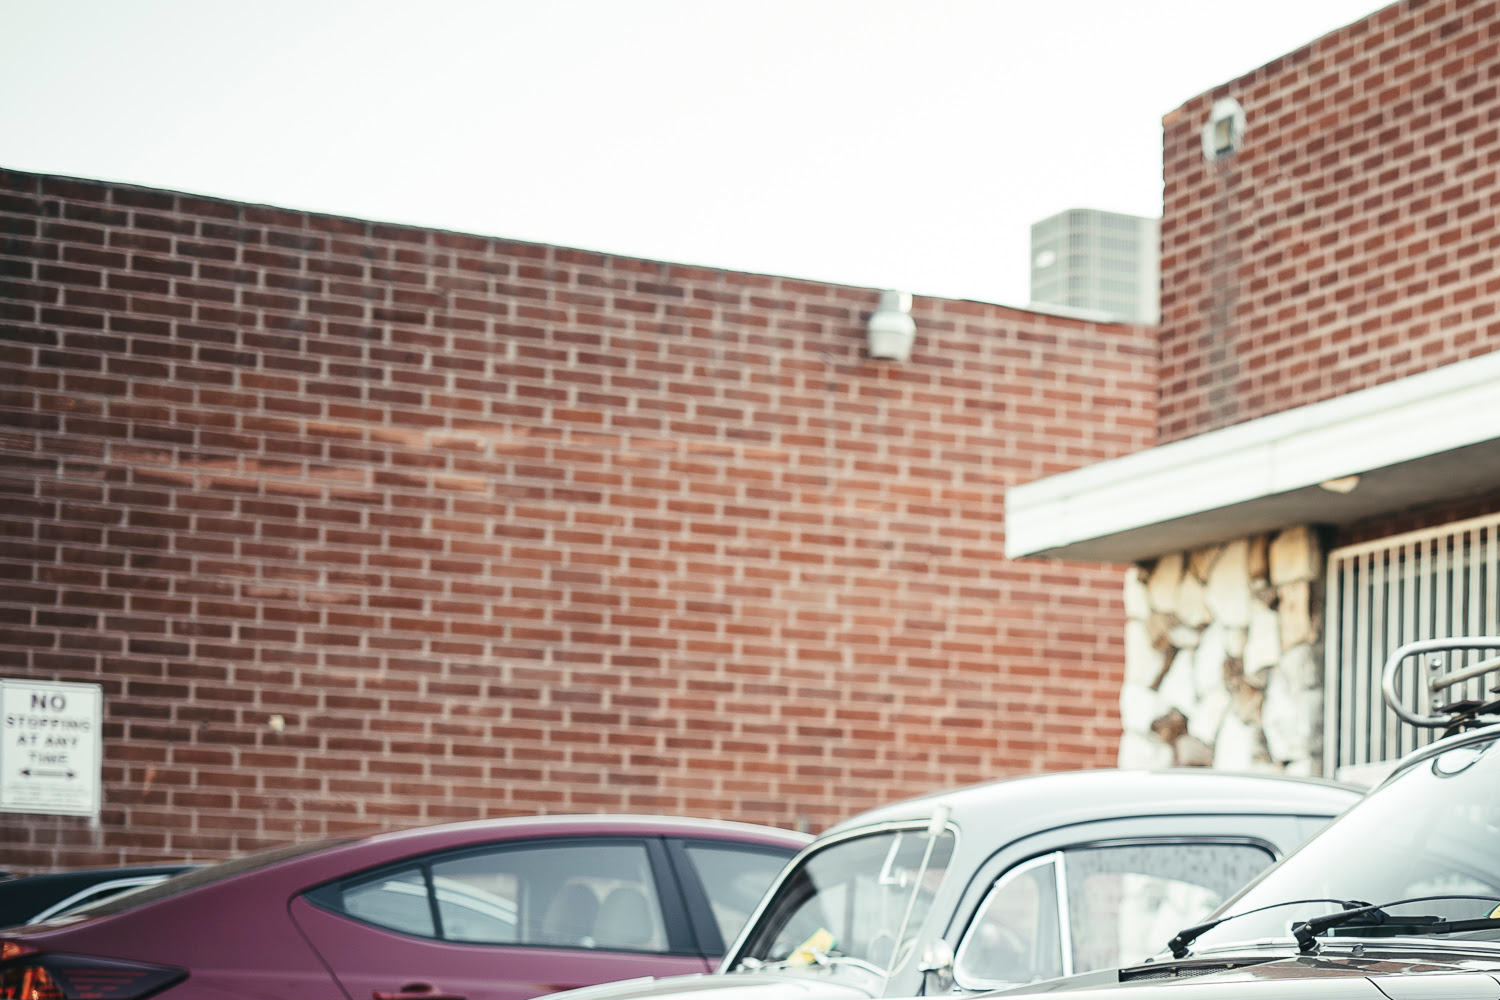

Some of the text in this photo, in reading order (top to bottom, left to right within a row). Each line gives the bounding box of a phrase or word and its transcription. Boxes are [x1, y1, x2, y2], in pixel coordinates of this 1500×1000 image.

[30, 693, 67, 711] NO
[6, 715, 91, 731] STOPPING
[17, 735, 79, 748] AT ANY
[28, 750, 69, 765] TIME
